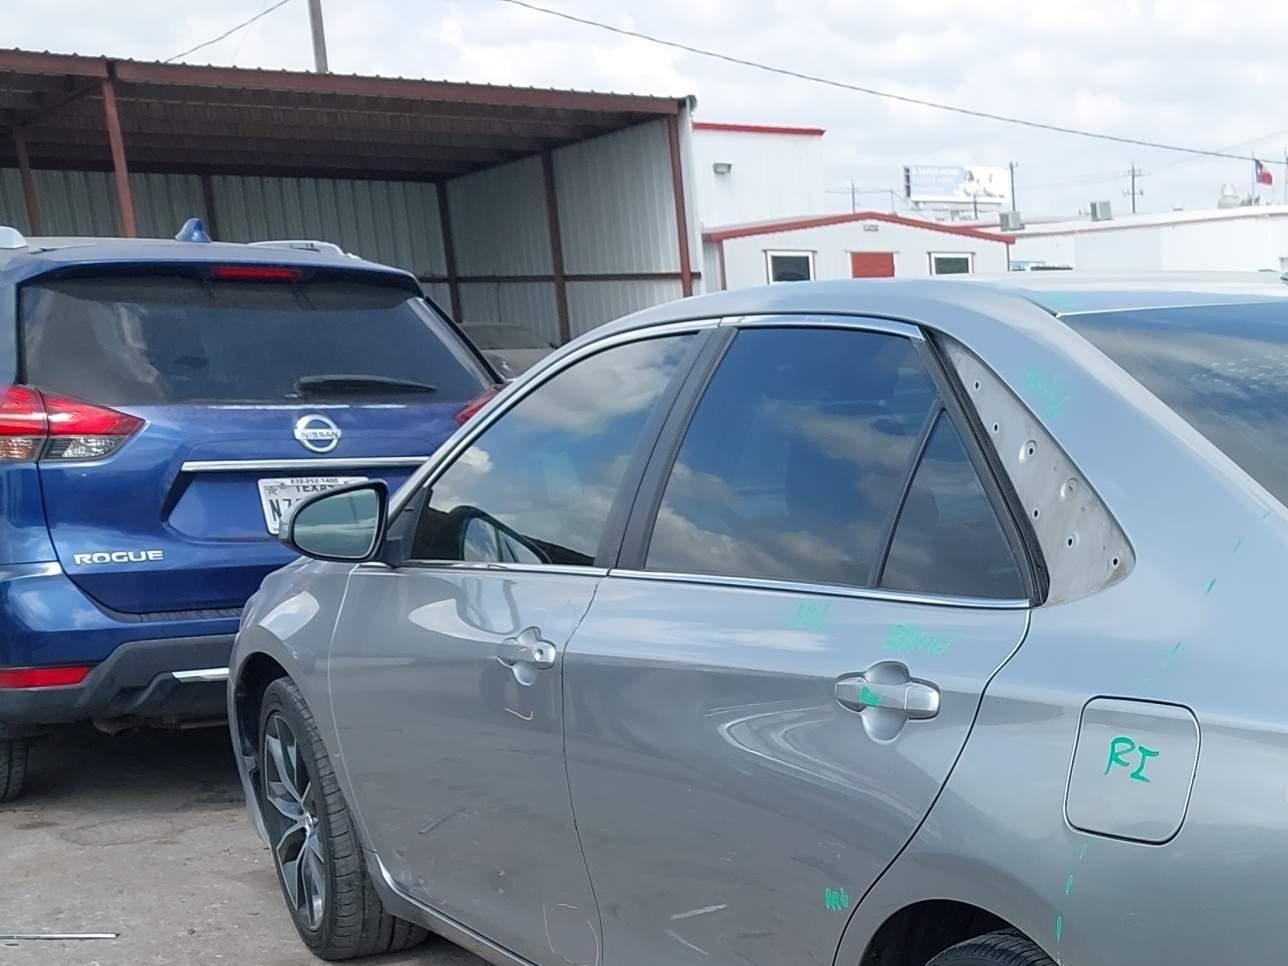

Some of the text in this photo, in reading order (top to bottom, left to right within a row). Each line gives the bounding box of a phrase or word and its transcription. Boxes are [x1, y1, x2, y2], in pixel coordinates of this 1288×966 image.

[301, 431, 338, 439] NISSAN
[73, 550, 164, 565] ROGUE
[1104, 736, 1160, 783] RI
